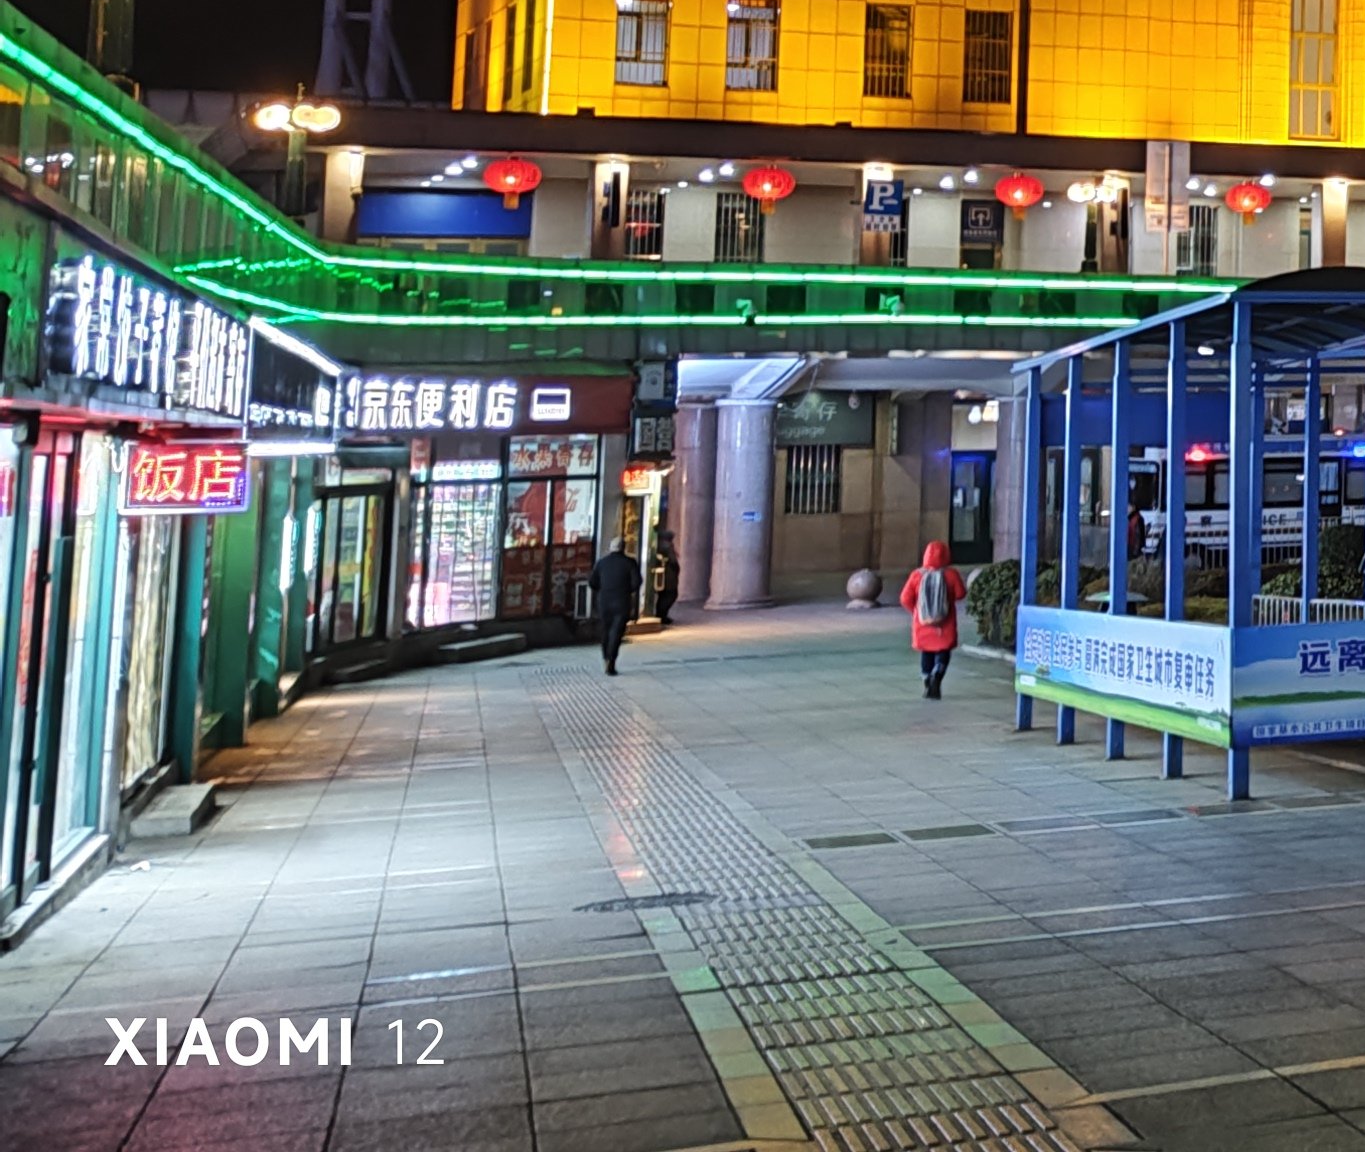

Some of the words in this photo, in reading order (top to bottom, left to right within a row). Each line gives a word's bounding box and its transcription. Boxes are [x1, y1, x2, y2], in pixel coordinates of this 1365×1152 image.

[360, 380, 518, 429] 京东便利店
[133, 450, 242, 501] 饭店
